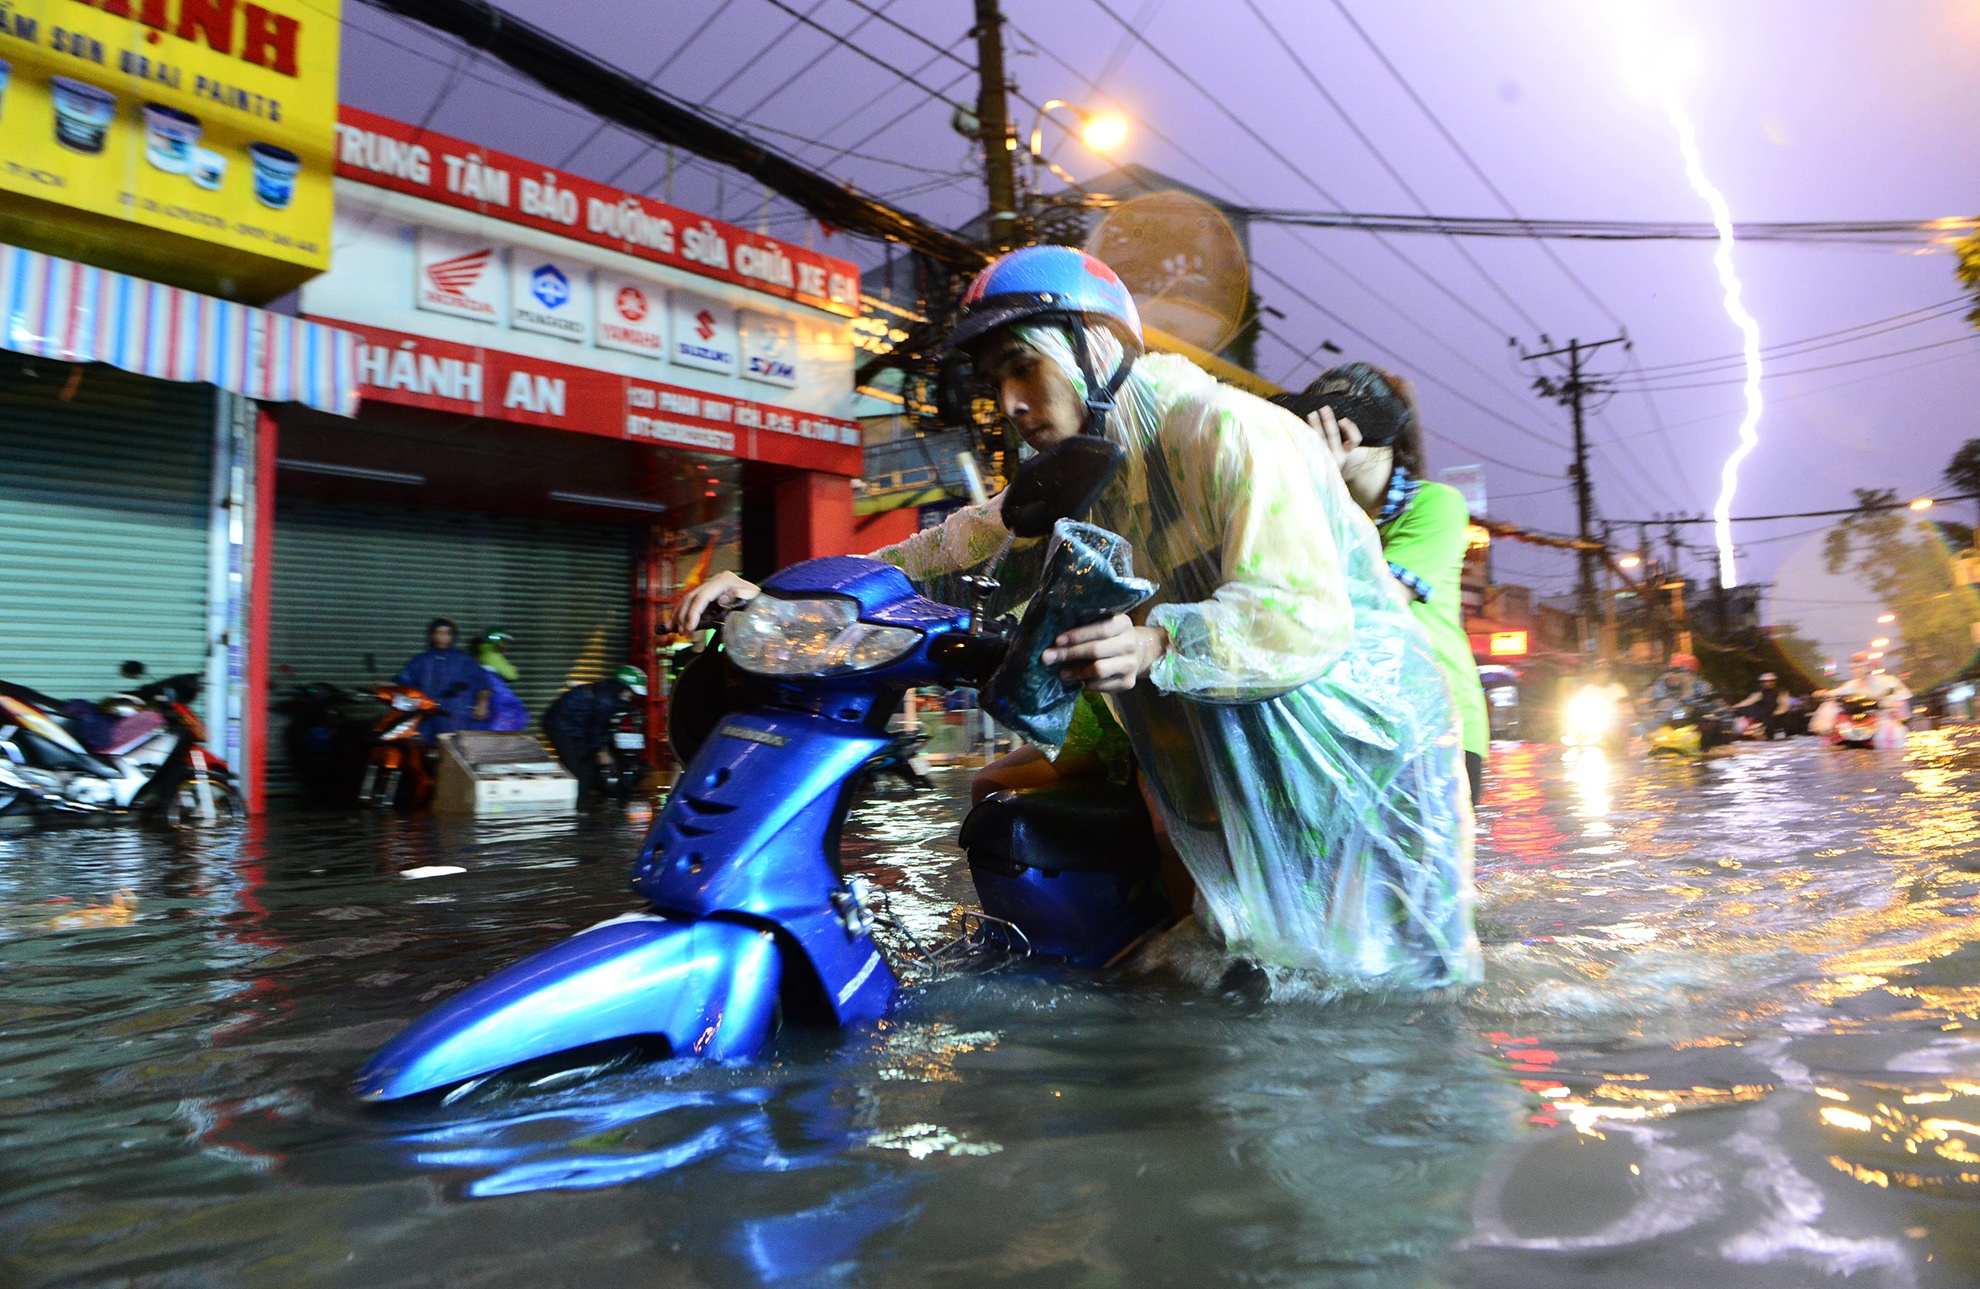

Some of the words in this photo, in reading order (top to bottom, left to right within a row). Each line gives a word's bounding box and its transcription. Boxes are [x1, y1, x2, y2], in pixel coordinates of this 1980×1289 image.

[443, 152, 510, 207] TÂM
[519, 171, 579, 226] BẢO
[587, 197, 675, 254] DƯỠNG
[681, 221, 730, 270] SỬA
[735, 242, 794, 289] CHỮA
[796, 261, 827, 297] XE
[356, 339, 483, 402] HÁNH
[502, 370, 567, 417] AN
[678, 341, 733, 365] SUZUKI
[749, 355, 796, 379] SYM
